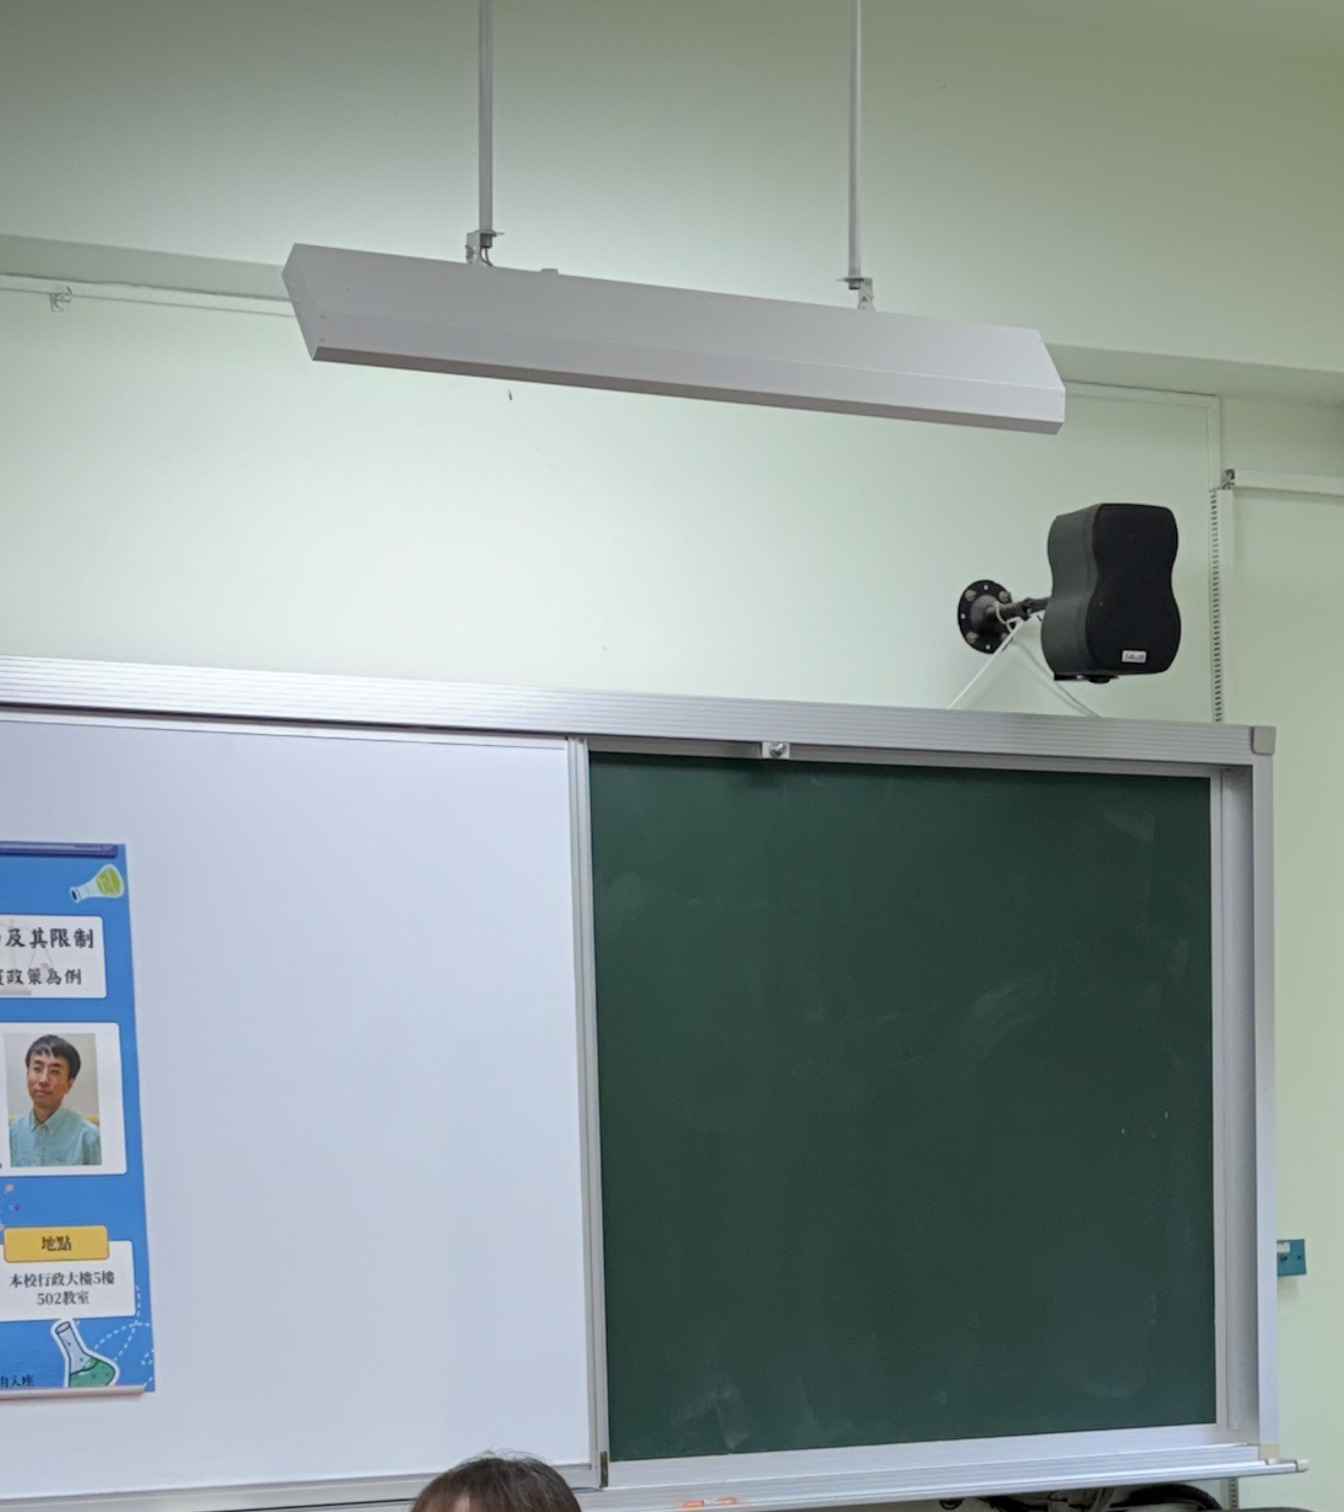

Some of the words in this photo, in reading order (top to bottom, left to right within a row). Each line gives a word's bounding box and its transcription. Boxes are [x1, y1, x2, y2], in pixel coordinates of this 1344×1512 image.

[41, 1235, 72, 1252] 地點
[9, 1271, 115, 1288] 本校行政大樓5樓
[37, 1290, 90, 1306] 502教室
